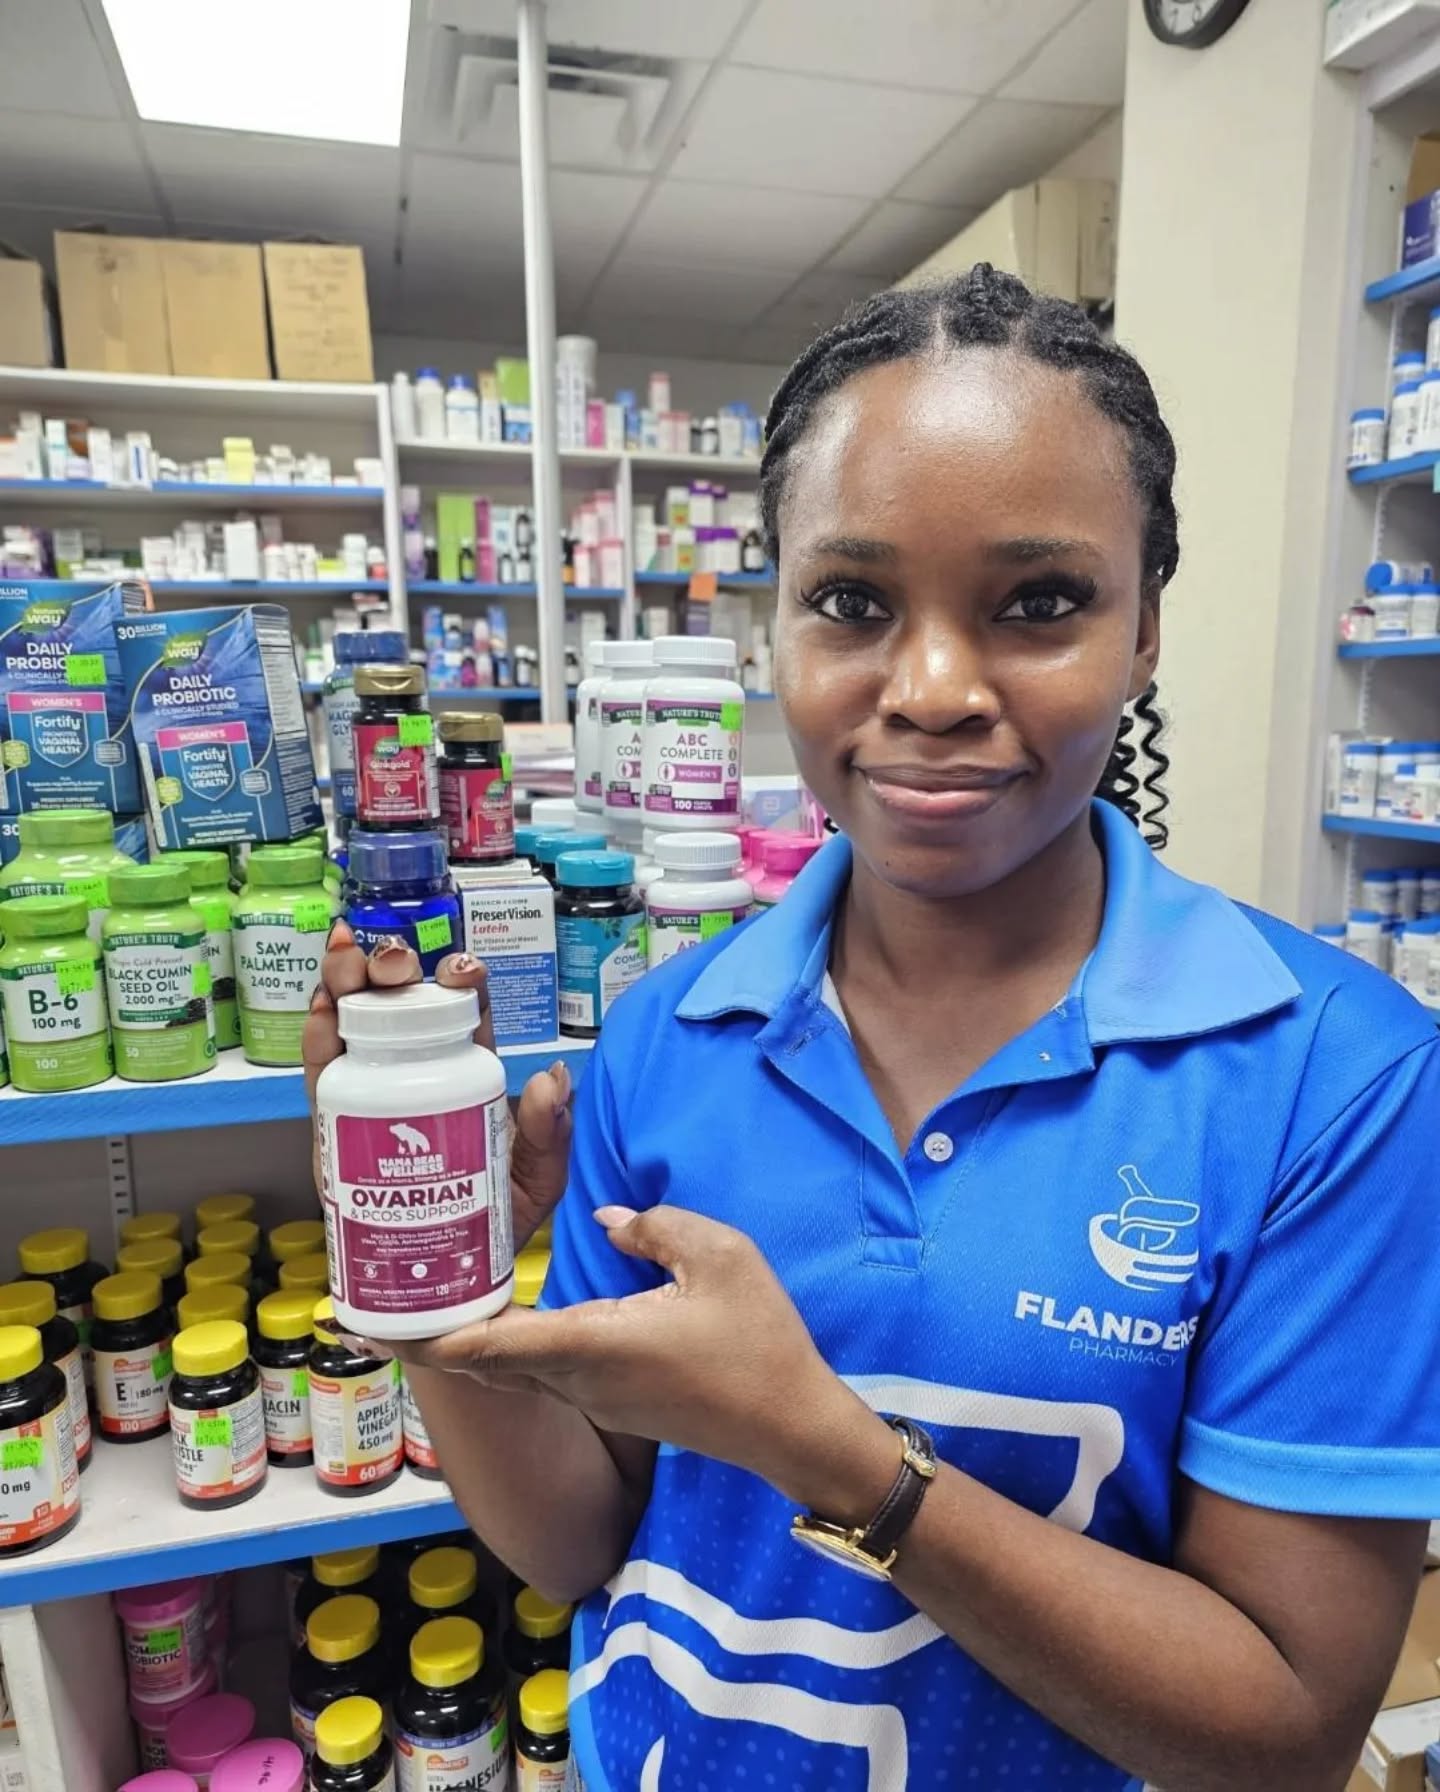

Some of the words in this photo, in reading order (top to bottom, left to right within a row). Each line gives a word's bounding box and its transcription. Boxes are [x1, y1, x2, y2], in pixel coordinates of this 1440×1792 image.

[117, 626, 136, 640] 30
[26, 642, 73, 656] DAILY
[6, 656, 67, 670] PROBIO
[169, 673, 213, 690] DAILY
[31, 697, 83, 707] WOMEN'S
[151, 686, 237, 706] PROBIOTIC
[700, 709, 721, 719] TRUT
[34, 715, 81, 730] Fortify
[38, 737, 83, 746] VAGINAL
[177, 729, 227, 741] WOMEN'S
[676, 733, 709, 747] ABC
[42, 745, 81, 754] HEALTH
[183, 747, 228, 762] Fortify
[660, 746, 723, 760] COMPLETE
[678, 770, 717, 779] WOMEN'S
[192, 778, 228, 788] HEALTH
[674, 799, 692, 811] 100
[471, 906, 542, 922] PreserVision
[472, 923, 509, 935] Lutein
[255, 941, 291, 955] SAW
[240, 955, 318, 972] PALMETTO
[108, 967, 143, 981] BLACK
[146, 964, 192, 980] CUMIN
[120, 982, 152, 994] SEED
[156, 980, 180, 992] OIL
[251, 975, 280, 988] 2400
[284, 979, 304, 992] mg
[28, 989, 79, 1014] B-6
[158, 996, 175, 1006] mg
[32, 1017, 57, 1030] 100
[60, 1017, 82, 1030] mg
[36, 1058, 58, 1070] 100
[378, 1158, 412, 1167] MAMA
[379, 1163, 444, 1178] WELLNESS
[352, 1179, 473, 1208] OVARIAN
[350, 1207, 358, 1219] &
[362, 1209, 401, 1222] PCOS
[407, 1199, 476, 1221] SUPPORT
[435, 1283, 450, 1296] 120
[1014, 1290, 1200, 1351] FLANDERS
[1069, 1336, 1180, 1367] PHARMACY
[116, 1382, 127, 1402] E
[357, 1400, 389, 1423] APPLE
[119, 1420, 140, 1432] 100
[357, 1435, 380, 1450] 450
[176, 1446, 204, 1462] ISTLE
[360, 1466, 376, 1481] 60
[12, 1480, 31, 1494] mg
[135, 1648, 182, 1665] OBIOTIC
